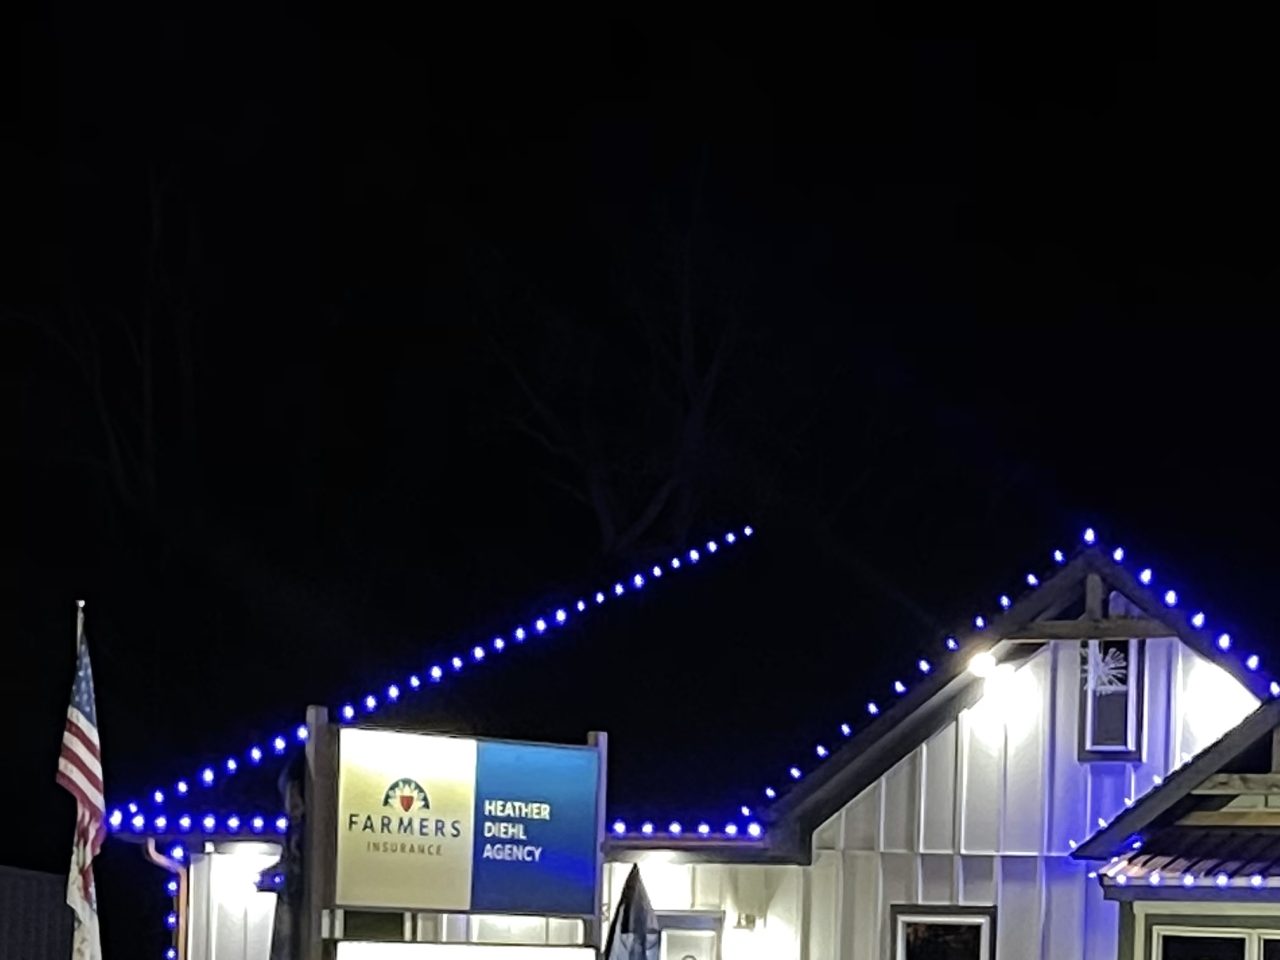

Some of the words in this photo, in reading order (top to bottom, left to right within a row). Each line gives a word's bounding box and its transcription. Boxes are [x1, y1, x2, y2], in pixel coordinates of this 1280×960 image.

[484, 800, 551, 820] HEATHER
[348, 814, 462, 838] FARMERS
[484, 821, 528, 840] DIEHL
[367, 841, 443, 857] INSURANCE
[483, 843, 543, 863] AGENCY
